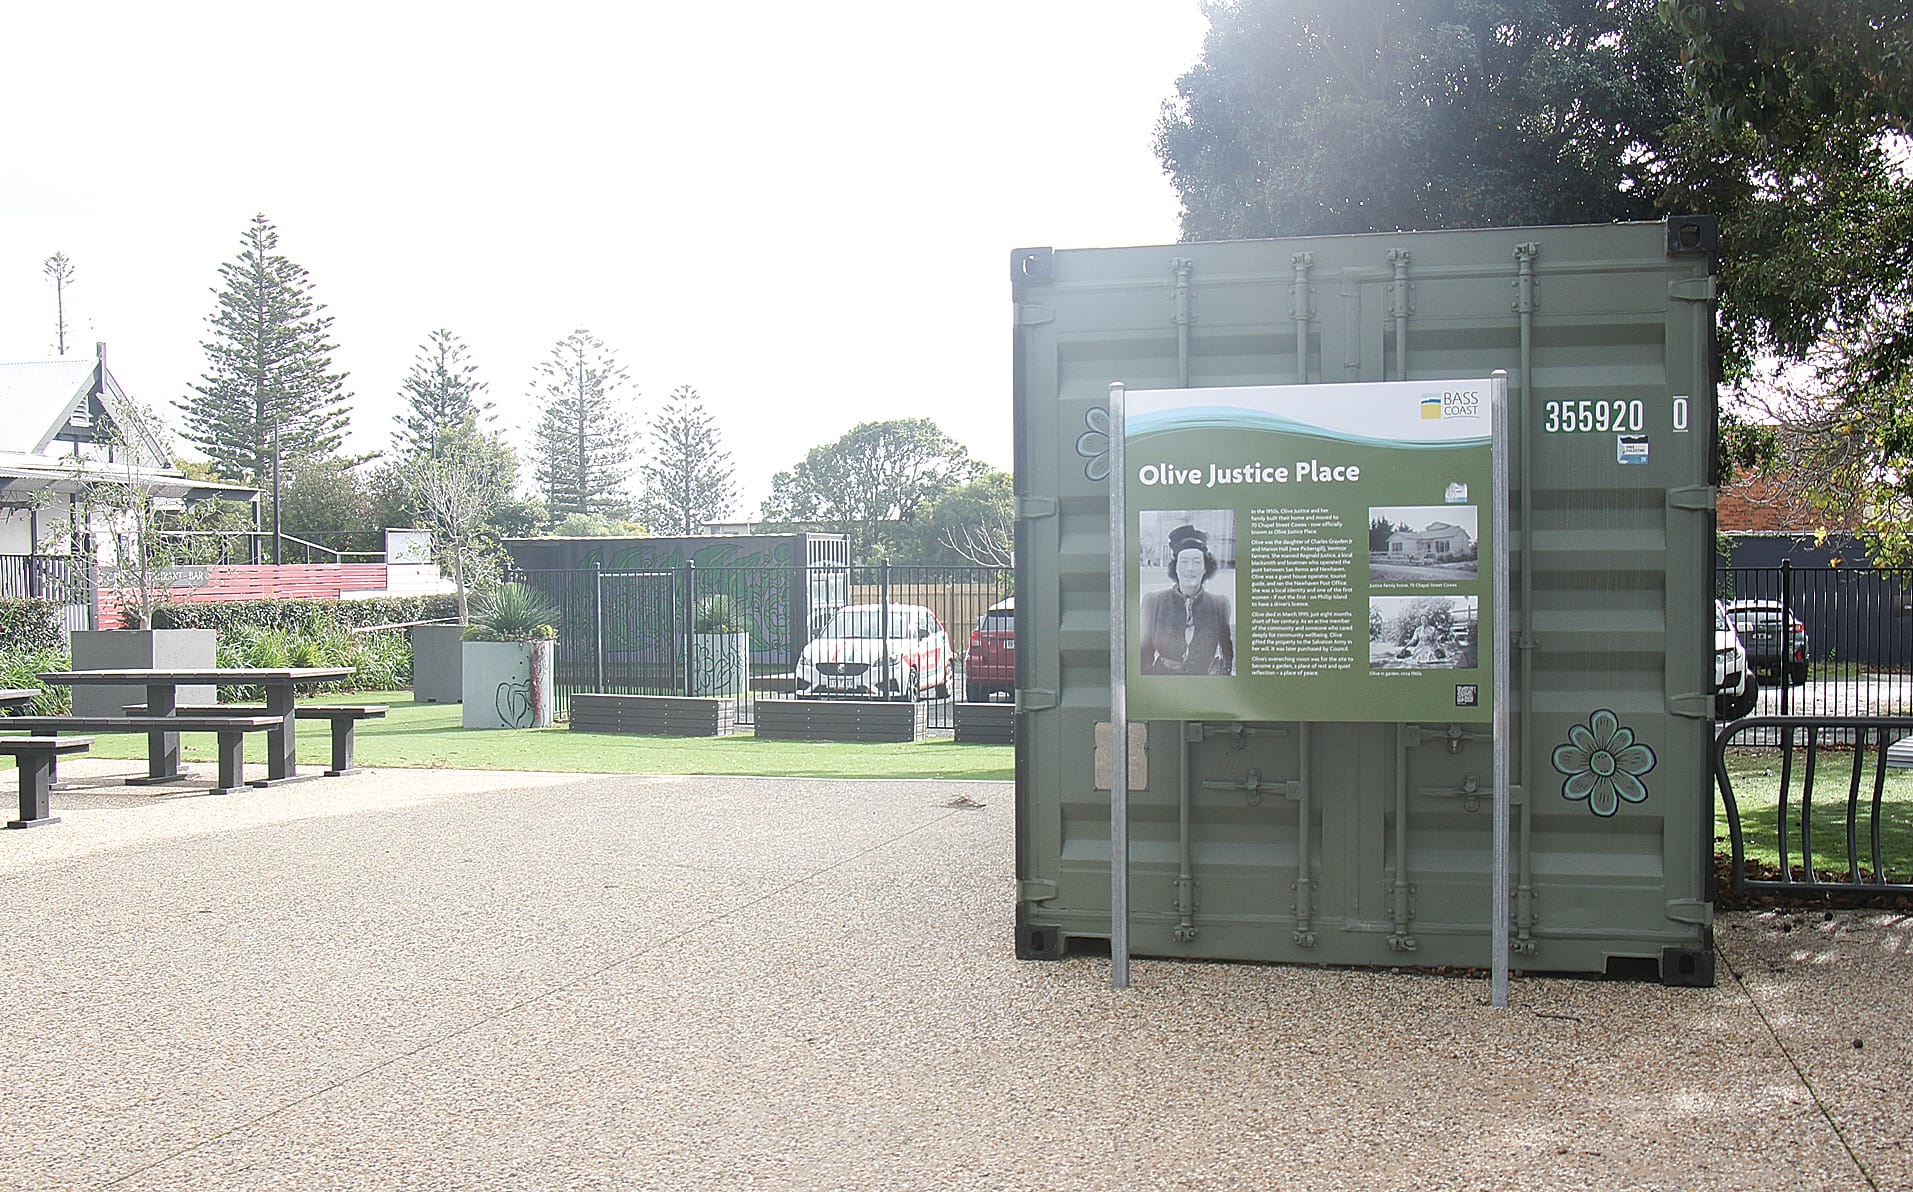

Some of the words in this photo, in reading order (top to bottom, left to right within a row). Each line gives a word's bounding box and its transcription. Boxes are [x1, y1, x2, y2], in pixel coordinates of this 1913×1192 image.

[1444, 391, 1479, 406] BASS
[1444, 406, 1478, 416] COAST
[1545, 400, 1644, 432] 355920
[1673, 399, 1688, 430] 0
[1139, 464, 1202, 486] Olive
[1206, 462, 1288, 488] Justice
[1296, 460, 1360, 482] Place
